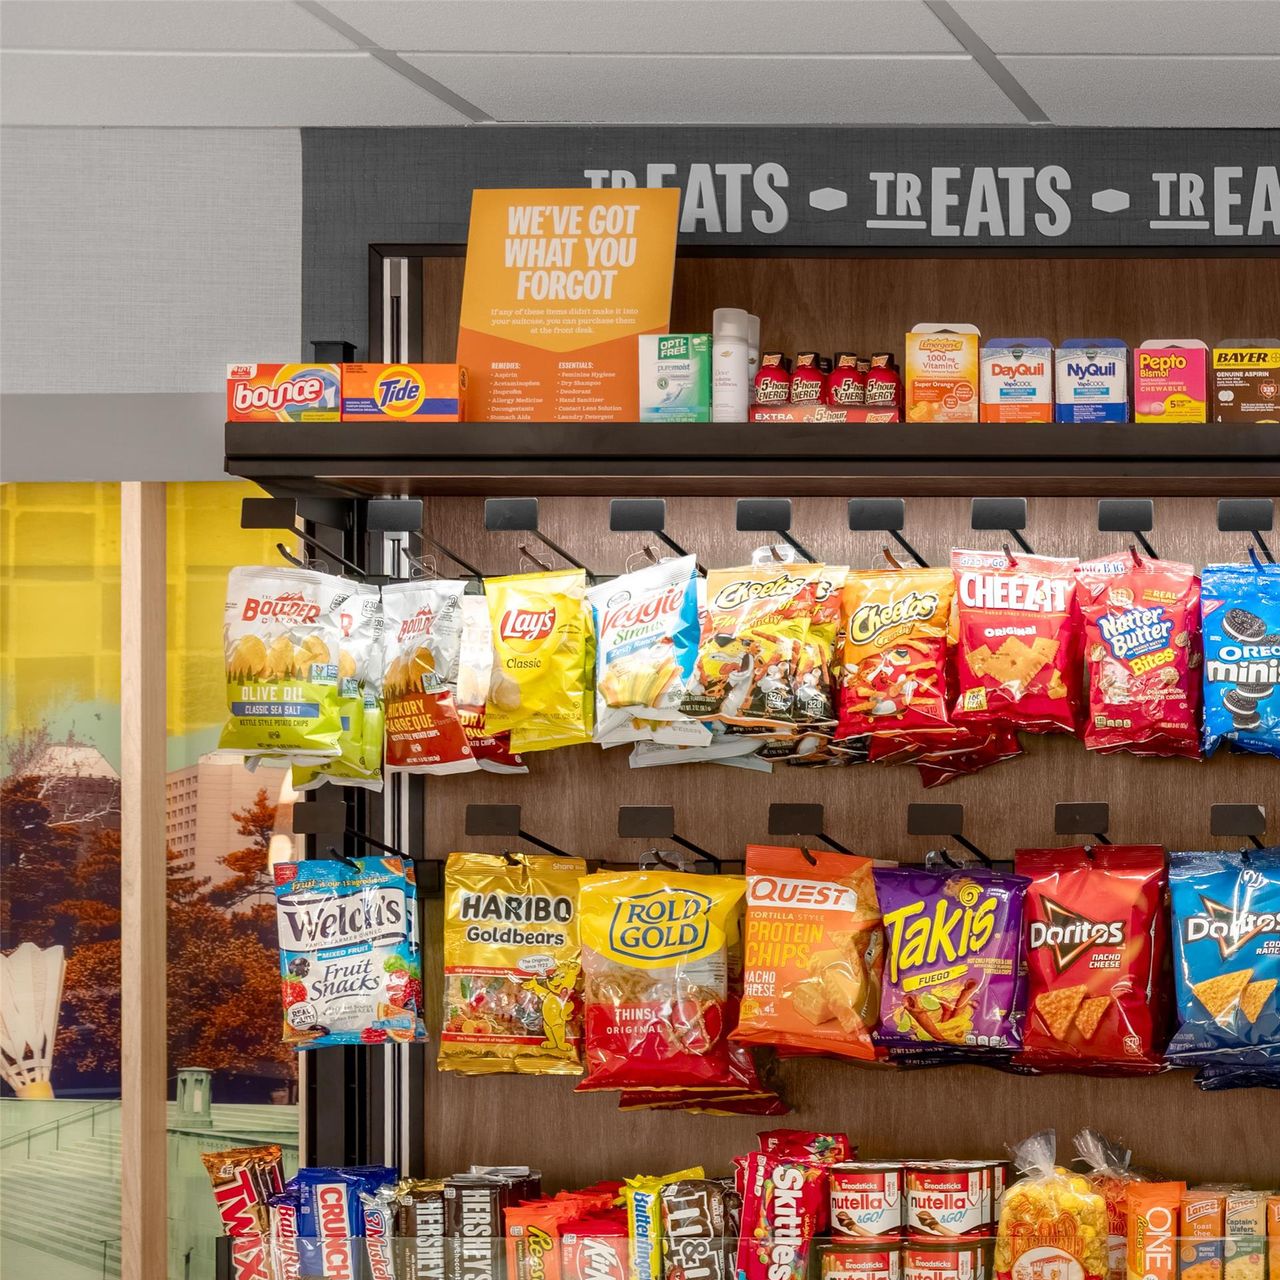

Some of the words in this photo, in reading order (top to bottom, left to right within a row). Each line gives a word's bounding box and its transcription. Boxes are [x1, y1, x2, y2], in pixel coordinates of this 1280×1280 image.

[584, 164, 789, 234] ATS
[869, 165, 1072, 237] TREATS
[508, 205, 584, 235] WE'VE
[589, 205, 640, 234] GOT
[505, 238, 577, 267] WHAT
[584, 237, 637, 267] YOU
[518, 270, 618, 301] FORGOT
[578, 317, 614, 325] purchase
[1139, 354, 1187, 371] Pepto
[1217, 352, 1270, 363] BAYER
[992, 363, 1044, 379] DayQuil
[1067, 363, 1116, 378] NyQuil
[1140, 369, 1169, 377] Bismol
[235, 379, 322, 409] bounce
[379, 379, 420, 408] Tide
[503, 609, 555, 640] Lay's
[850, 592, 940, 644] Cheetos
[1110, 620, 1172, 658] Butter
[506, 658, 542, 669] Classic
[1129, 651, 1175, 676] Bites
[285, 705, 301, 715] SALT
[751, 877, 849, 905] QUEST
[283, 896, 402, 943] Welch's
[462, 895, 571, 922] HARIBO
[627, 899, 701, 925] ROLD
[750, 911, 794, 920] TORTILLA
[467, 926, 565, 946] Goldbears
[619, 923, 700, 949] GOLD
[884, 897, 998, 984] Takis
[1031, 922, 1123, 949] Doritos
[747, 942, 811, 968] CHIPS
[1092, 953, 1121, 961] NACHO
[323, 959, 372, 983] Fruit
[918, 970, 950, 986] FUEGO
[310, 974, 380, 999] Snacks
[614, 1008, 652, 1021] THINS
[911, 1194, 966, 1209] nutella
[1226, 1218, 1258, 1226] Captain's
[1145, 1207, 1172, 1270] ONE
